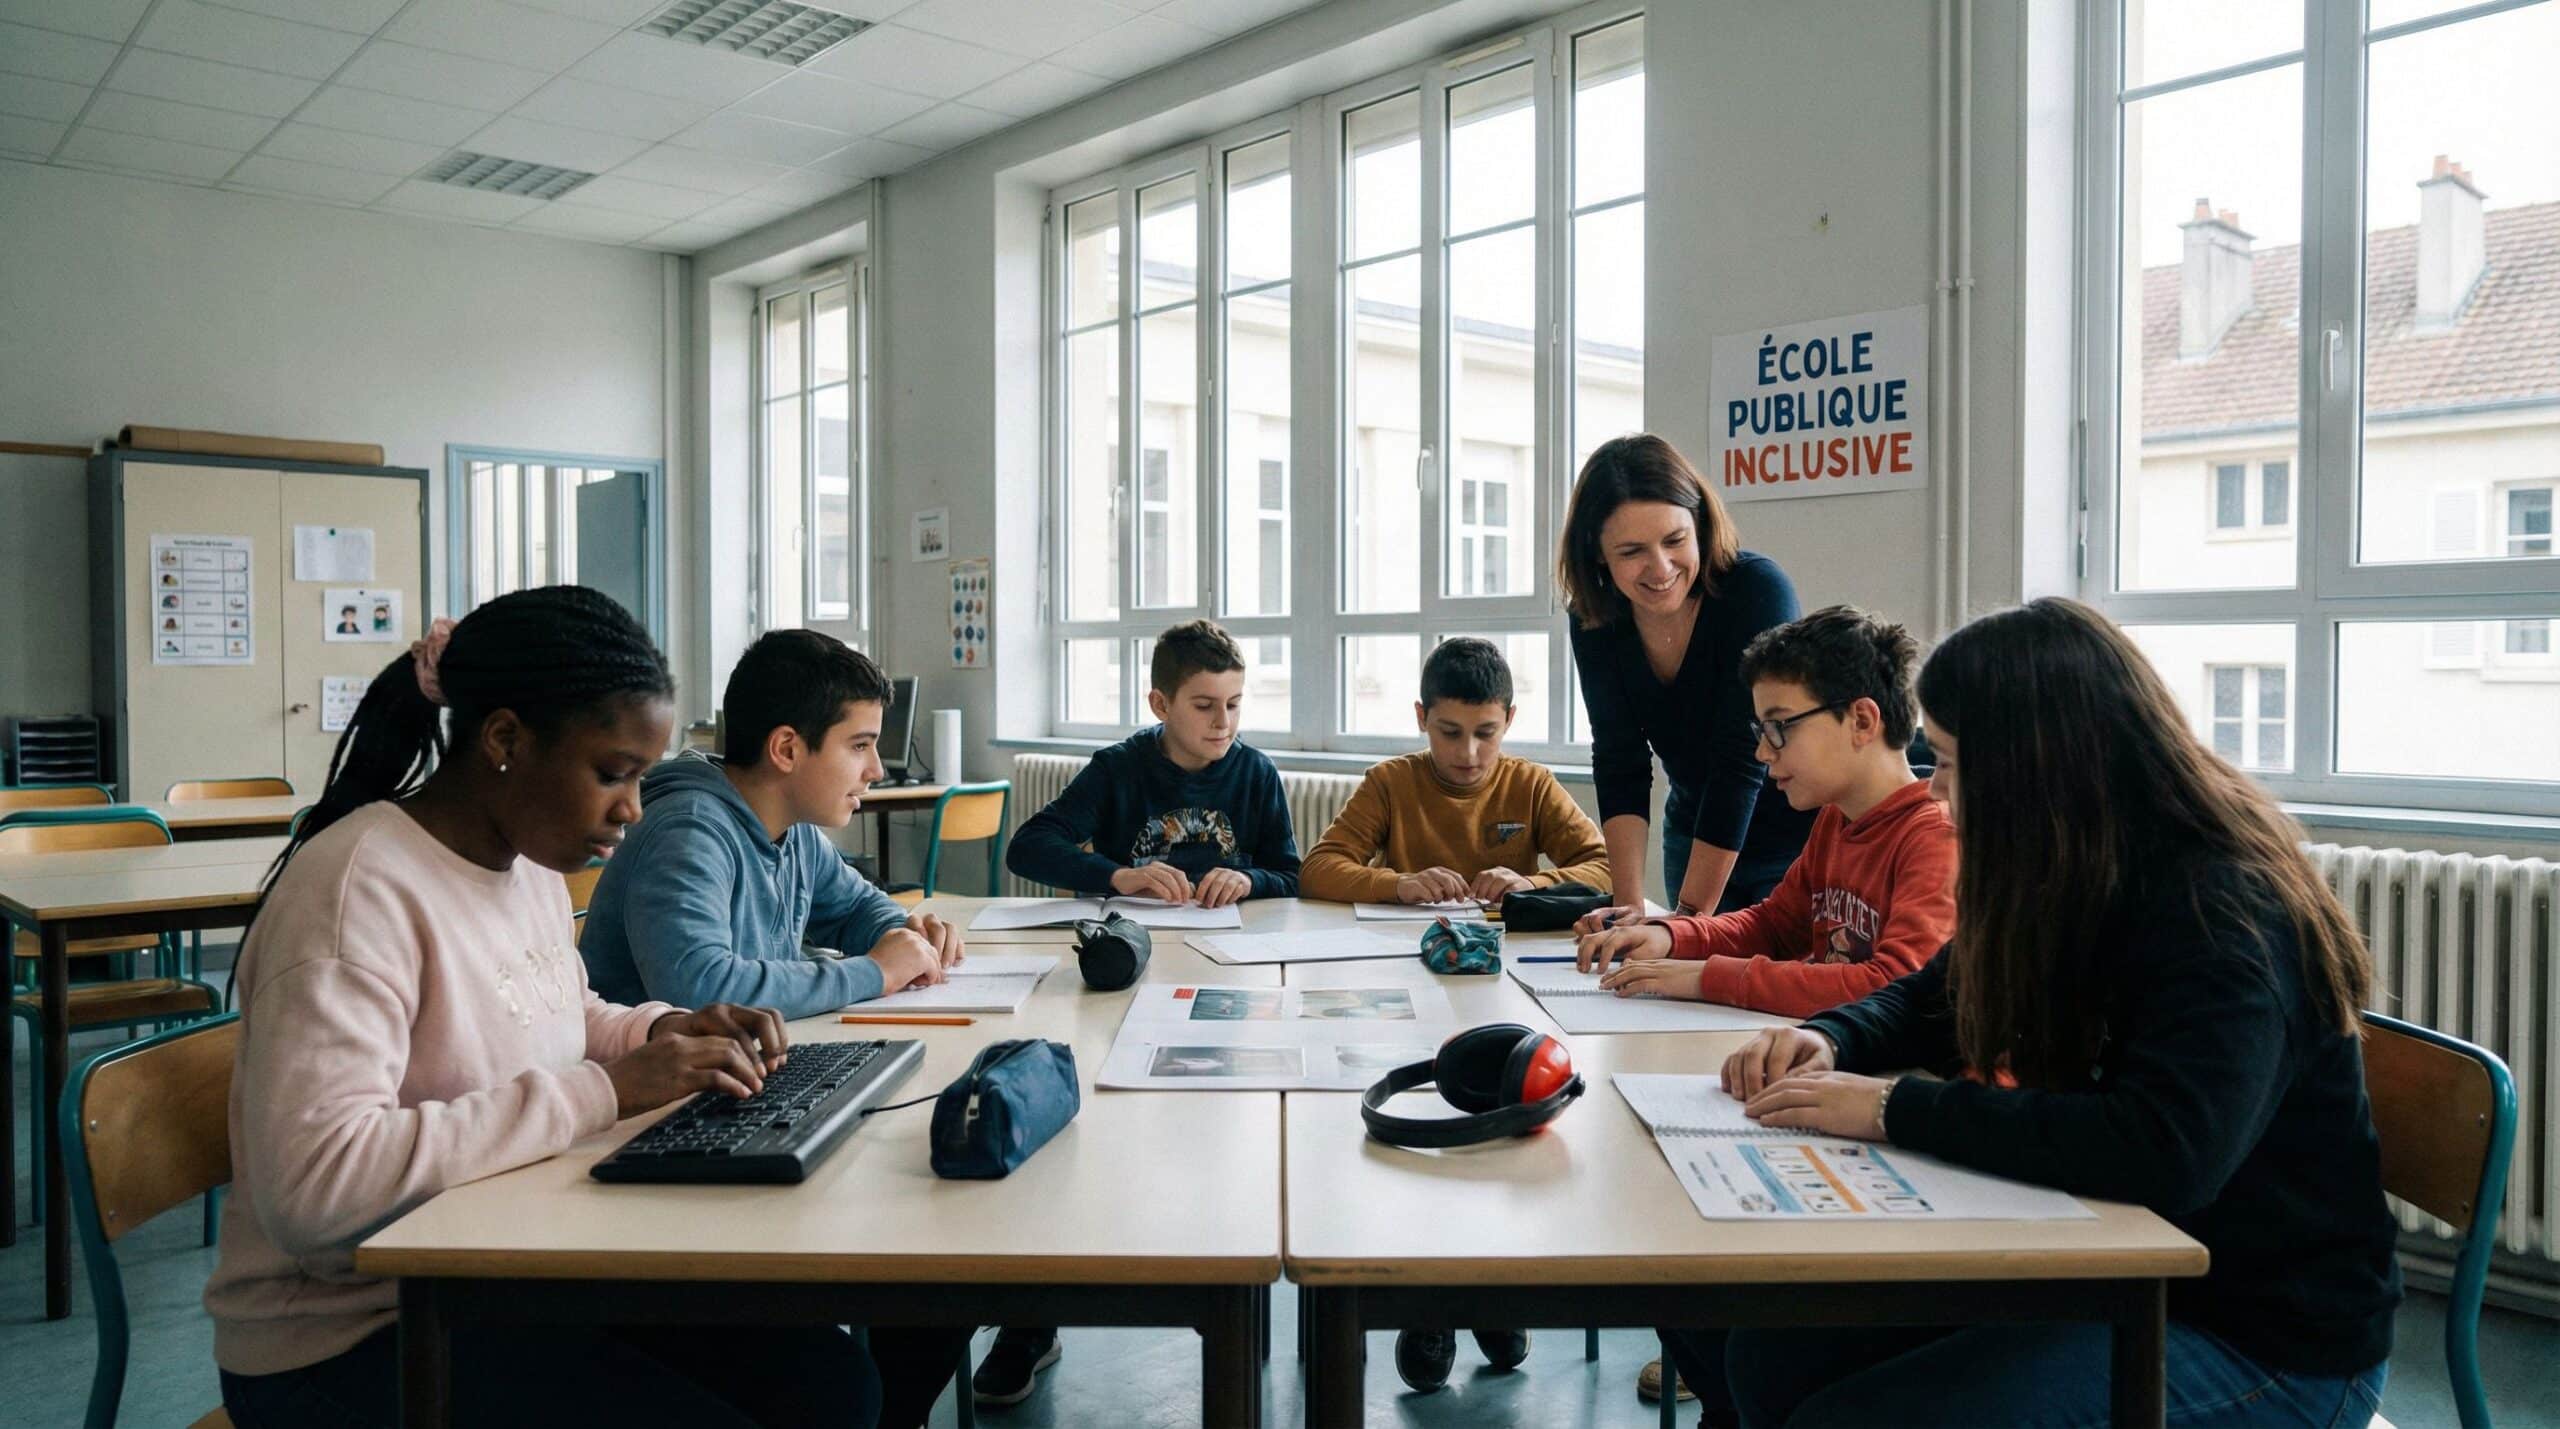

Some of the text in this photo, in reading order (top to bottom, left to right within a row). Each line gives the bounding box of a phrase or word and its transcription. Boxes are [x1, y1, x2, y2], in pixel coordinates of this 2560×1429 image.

[1758, 332, 1873, 385] ÉCOLE
[1728, 379, 1907, 438] PUBLIQUE
[1725, 432, 1913, 487] INCLUSIVE
